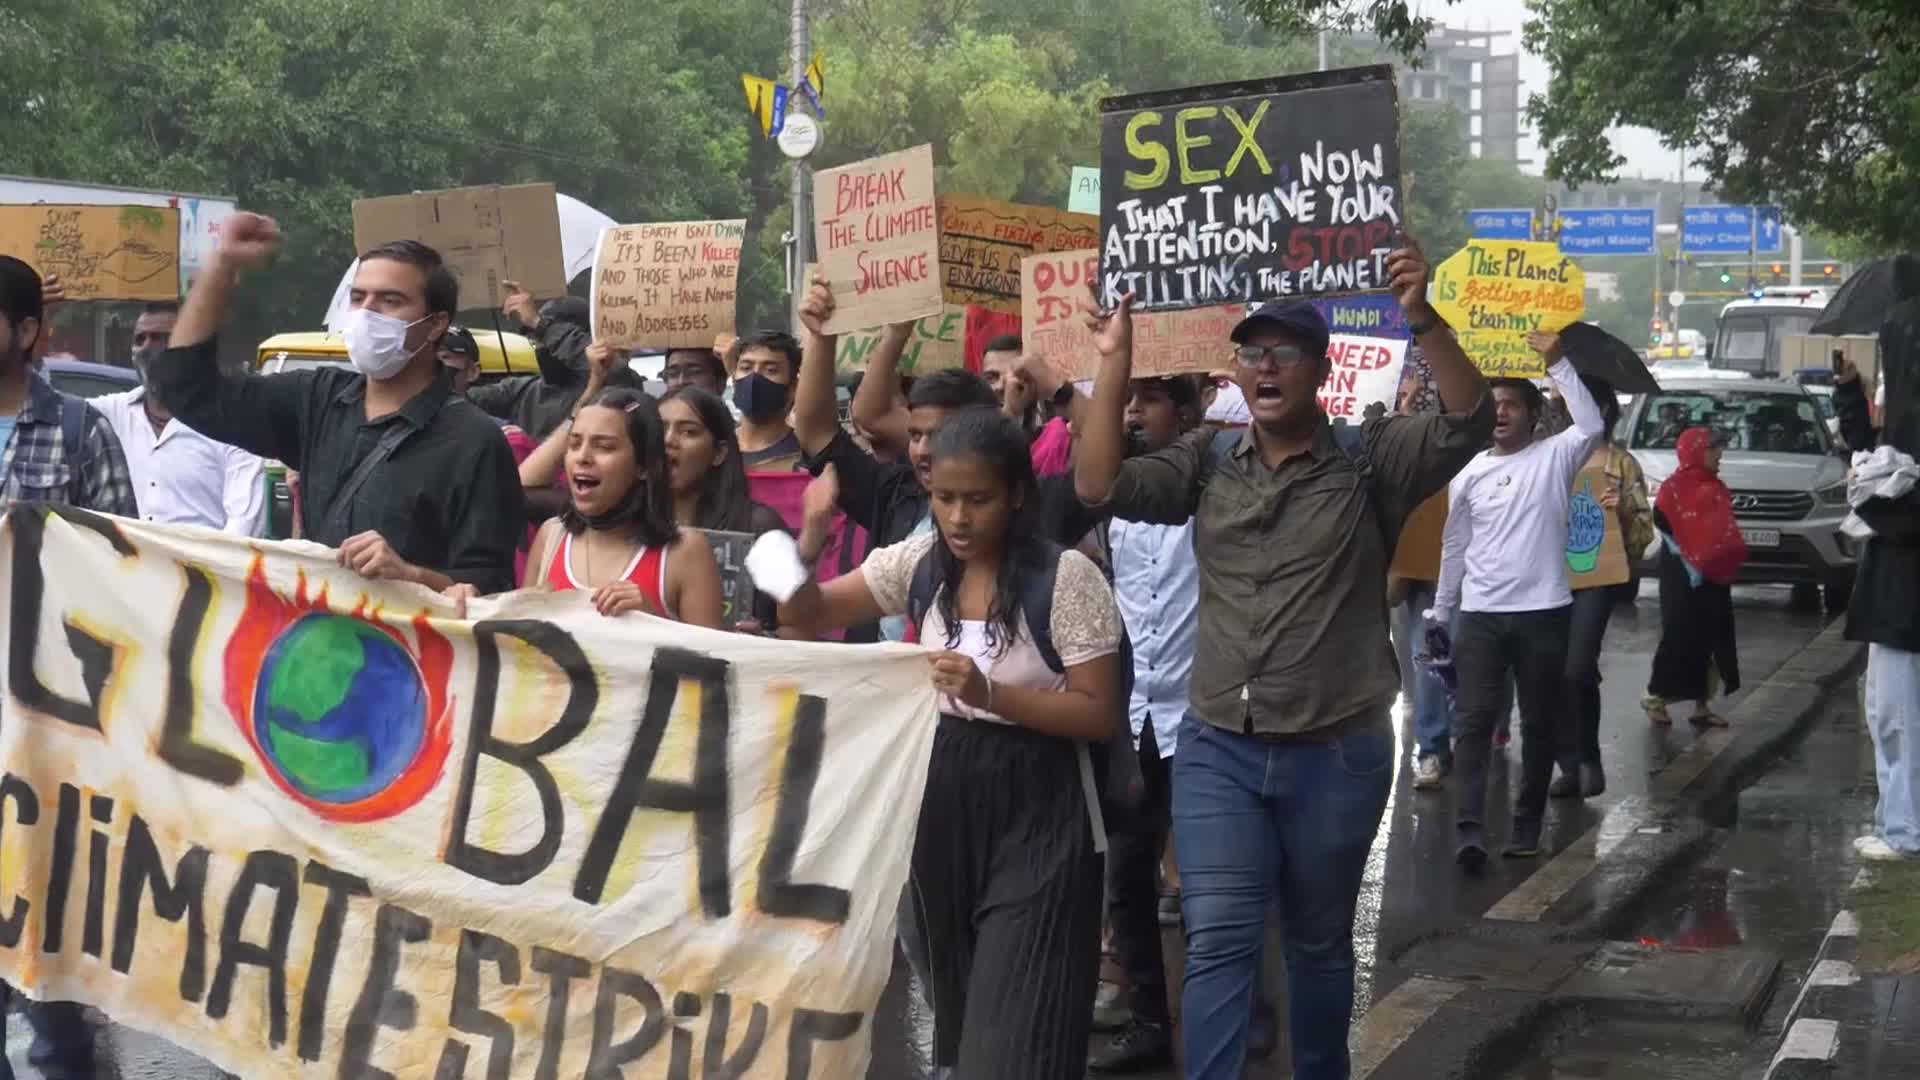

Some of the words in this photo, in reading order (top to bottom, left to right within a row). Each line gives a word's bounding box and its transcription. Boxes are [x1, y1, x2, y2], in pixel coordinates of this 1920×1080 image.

[1124, 99, 1273, 190] SEX
[1301, 140, 1384, 187] NOW
[836, 168, 905, 216] BREAK
[1117, 196, 1187, 231] THAT
[1200, 185, 1224, 232] I
[1234, 180, 1317, 226] HAVE
[1327, 182, 1399, 226] YOUR
[613, 230, 633, 241] THE
[641, 225, 678, 239] EARTH
[822, 218, 858, 249] THE
[865, 205, 934, 242] CLIMATE
[653, 241, 697, 263] BEEN
[1104, 217, 1278, 268] ATTENTION,
[1284, 221, 1390, 272] STOP
[601, 268, 626, 285] AND
[633, 267, 672, 285] THOSE
[678, 267, 707, 281] WHO
[711, 264, 736, 278] ARE
[854, 249, 929, 295] SILENCE
[1258, 268, 1292, 295] THE
[1299, 248, 1391, 293] PLANET
[1466, 246, 1502, 277] This
[1504, 248, 1568, 283] Planet
[671, 288, 702, 305] HAVE
[1440, 271, 1456, 301] is
[600, 316, 627, 336] AND
[635, 313, 709, 333] ADDRESSES
[1468, 305, 1505, 328] than
[1327, 342, 1392, 370] NEED
[1315, 396, 1357, 416] NGE
